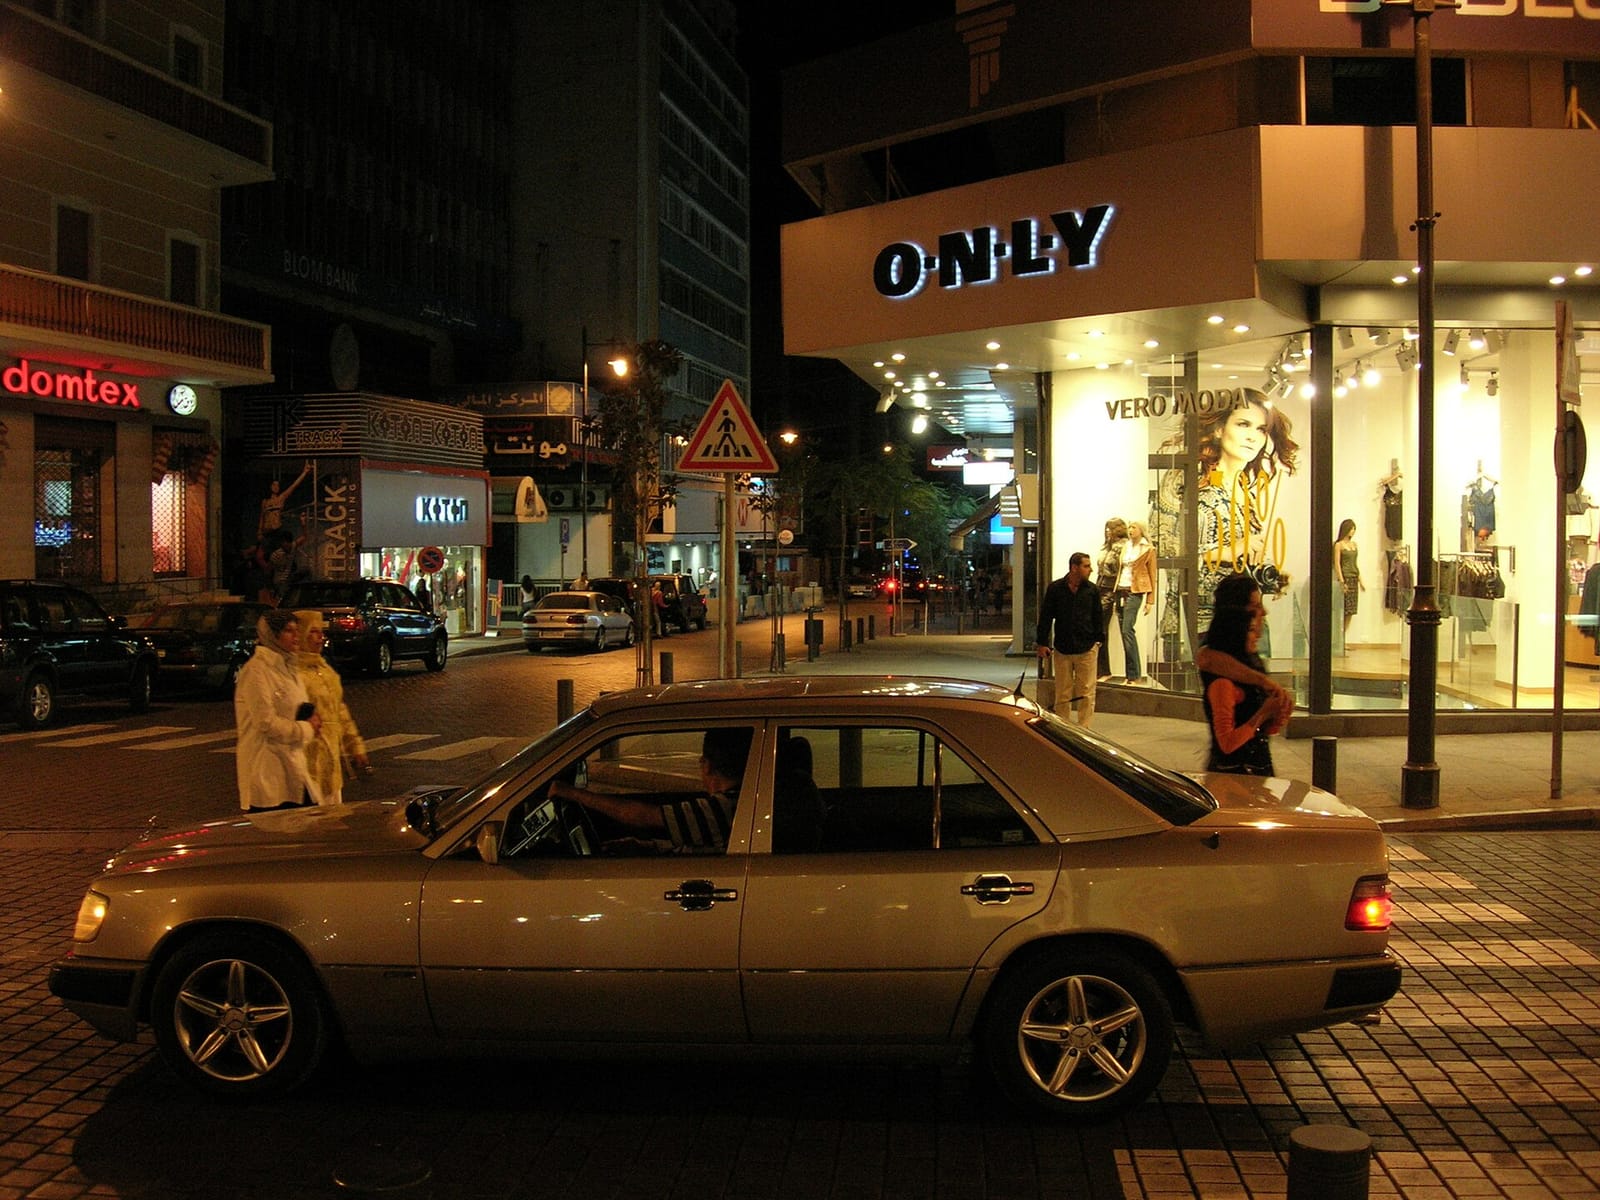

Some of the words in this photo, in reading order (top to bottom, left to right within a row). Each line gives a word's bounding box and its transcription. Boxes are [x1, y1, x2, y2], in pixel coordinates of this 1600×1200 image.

[326, 263, 359, 296] BANK
[2, 358, 141, 408] domtex
[1105, 393, 1166, 420] VERO
[1172, 387, 1250, 415] MODA
[295, 430, 342, 443] TRACK
[322, 484, 348, 578] TRACK
[348, 483, 358, 573] CLOTHING
